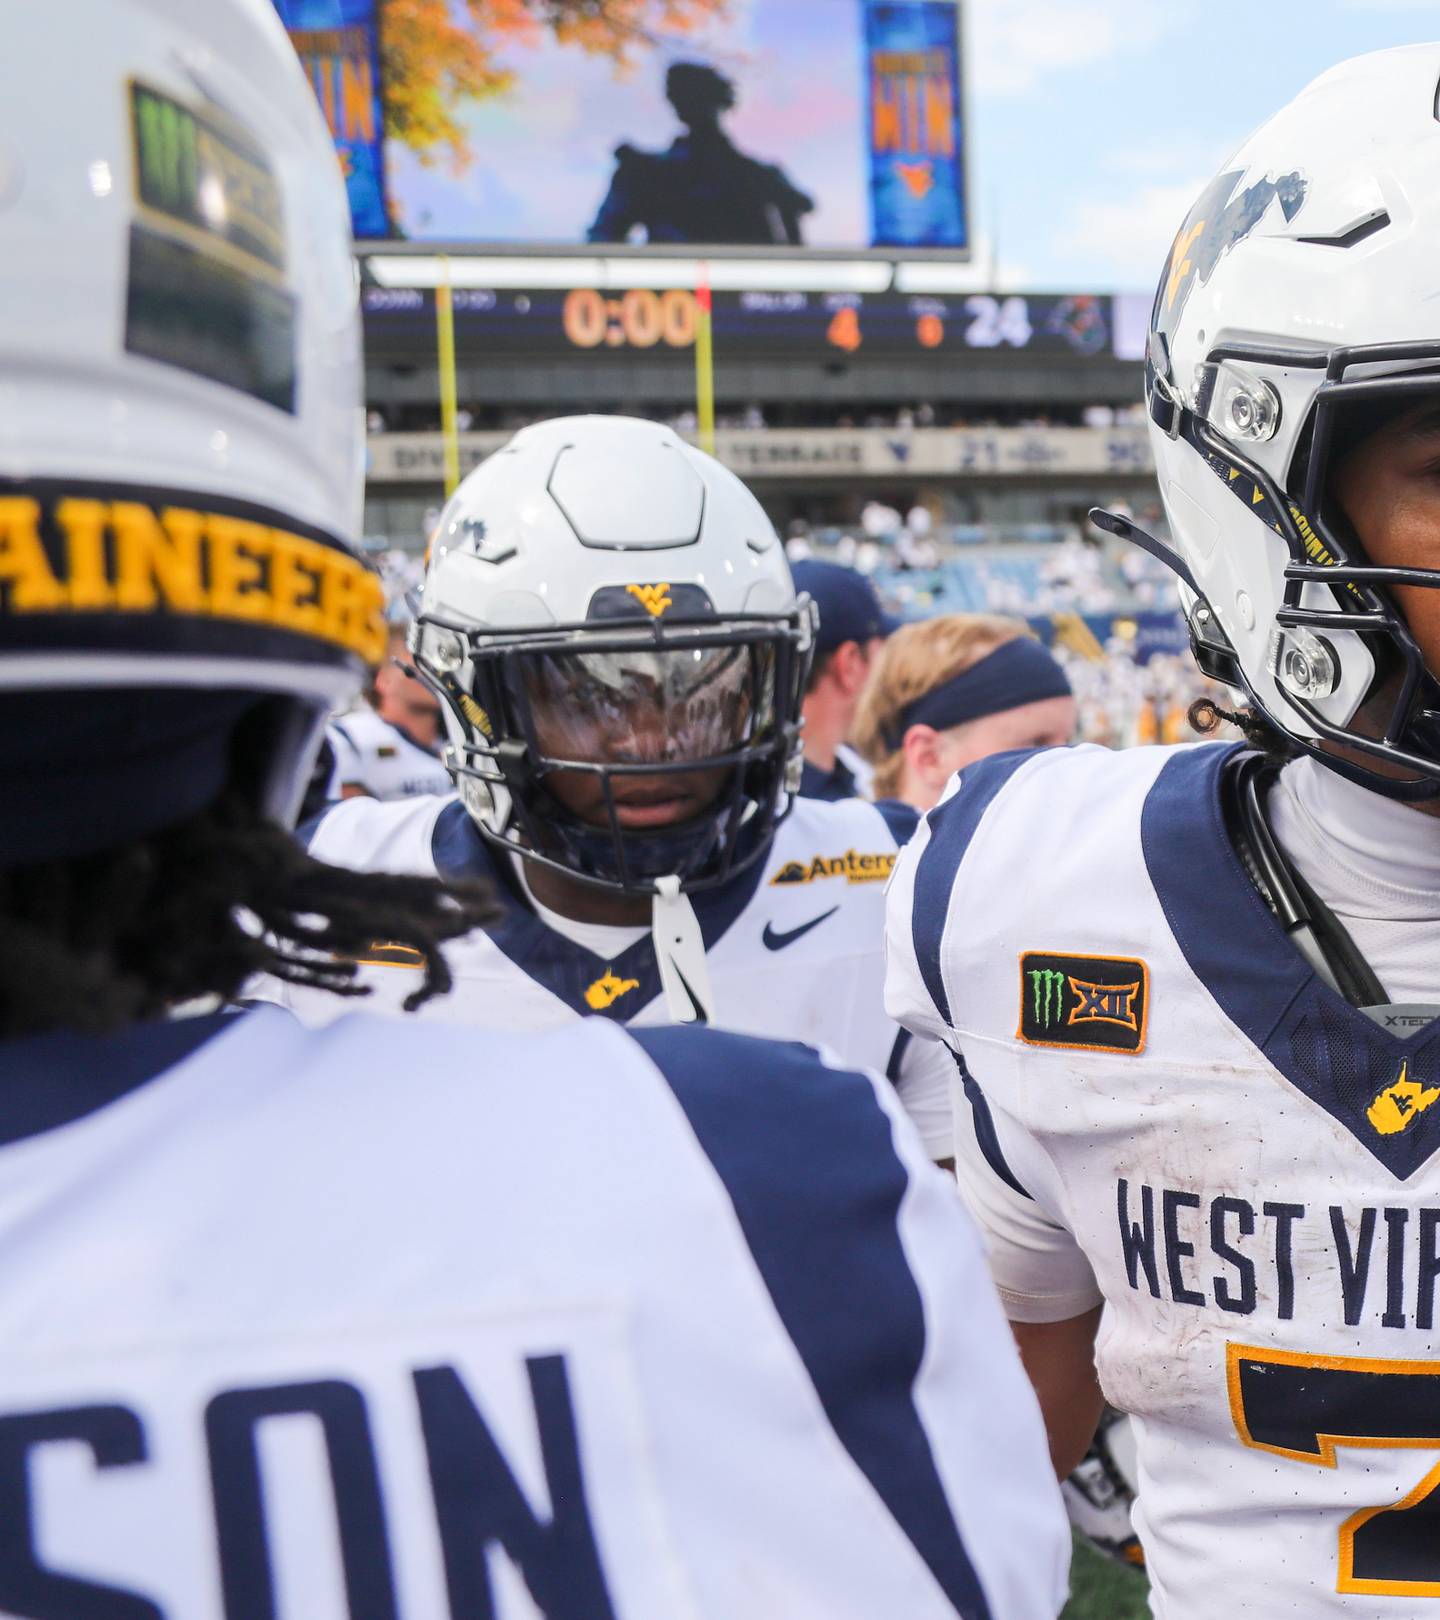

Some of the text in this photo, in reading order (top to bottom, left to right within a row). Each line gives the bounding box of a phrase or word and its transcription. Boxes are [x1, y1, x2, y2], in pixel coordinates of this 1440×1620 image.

[563, 287, 698, 348] 0:00
[963, 294, 1033, 348] 24
[1116, 1177, 1304, 1320] WEST
